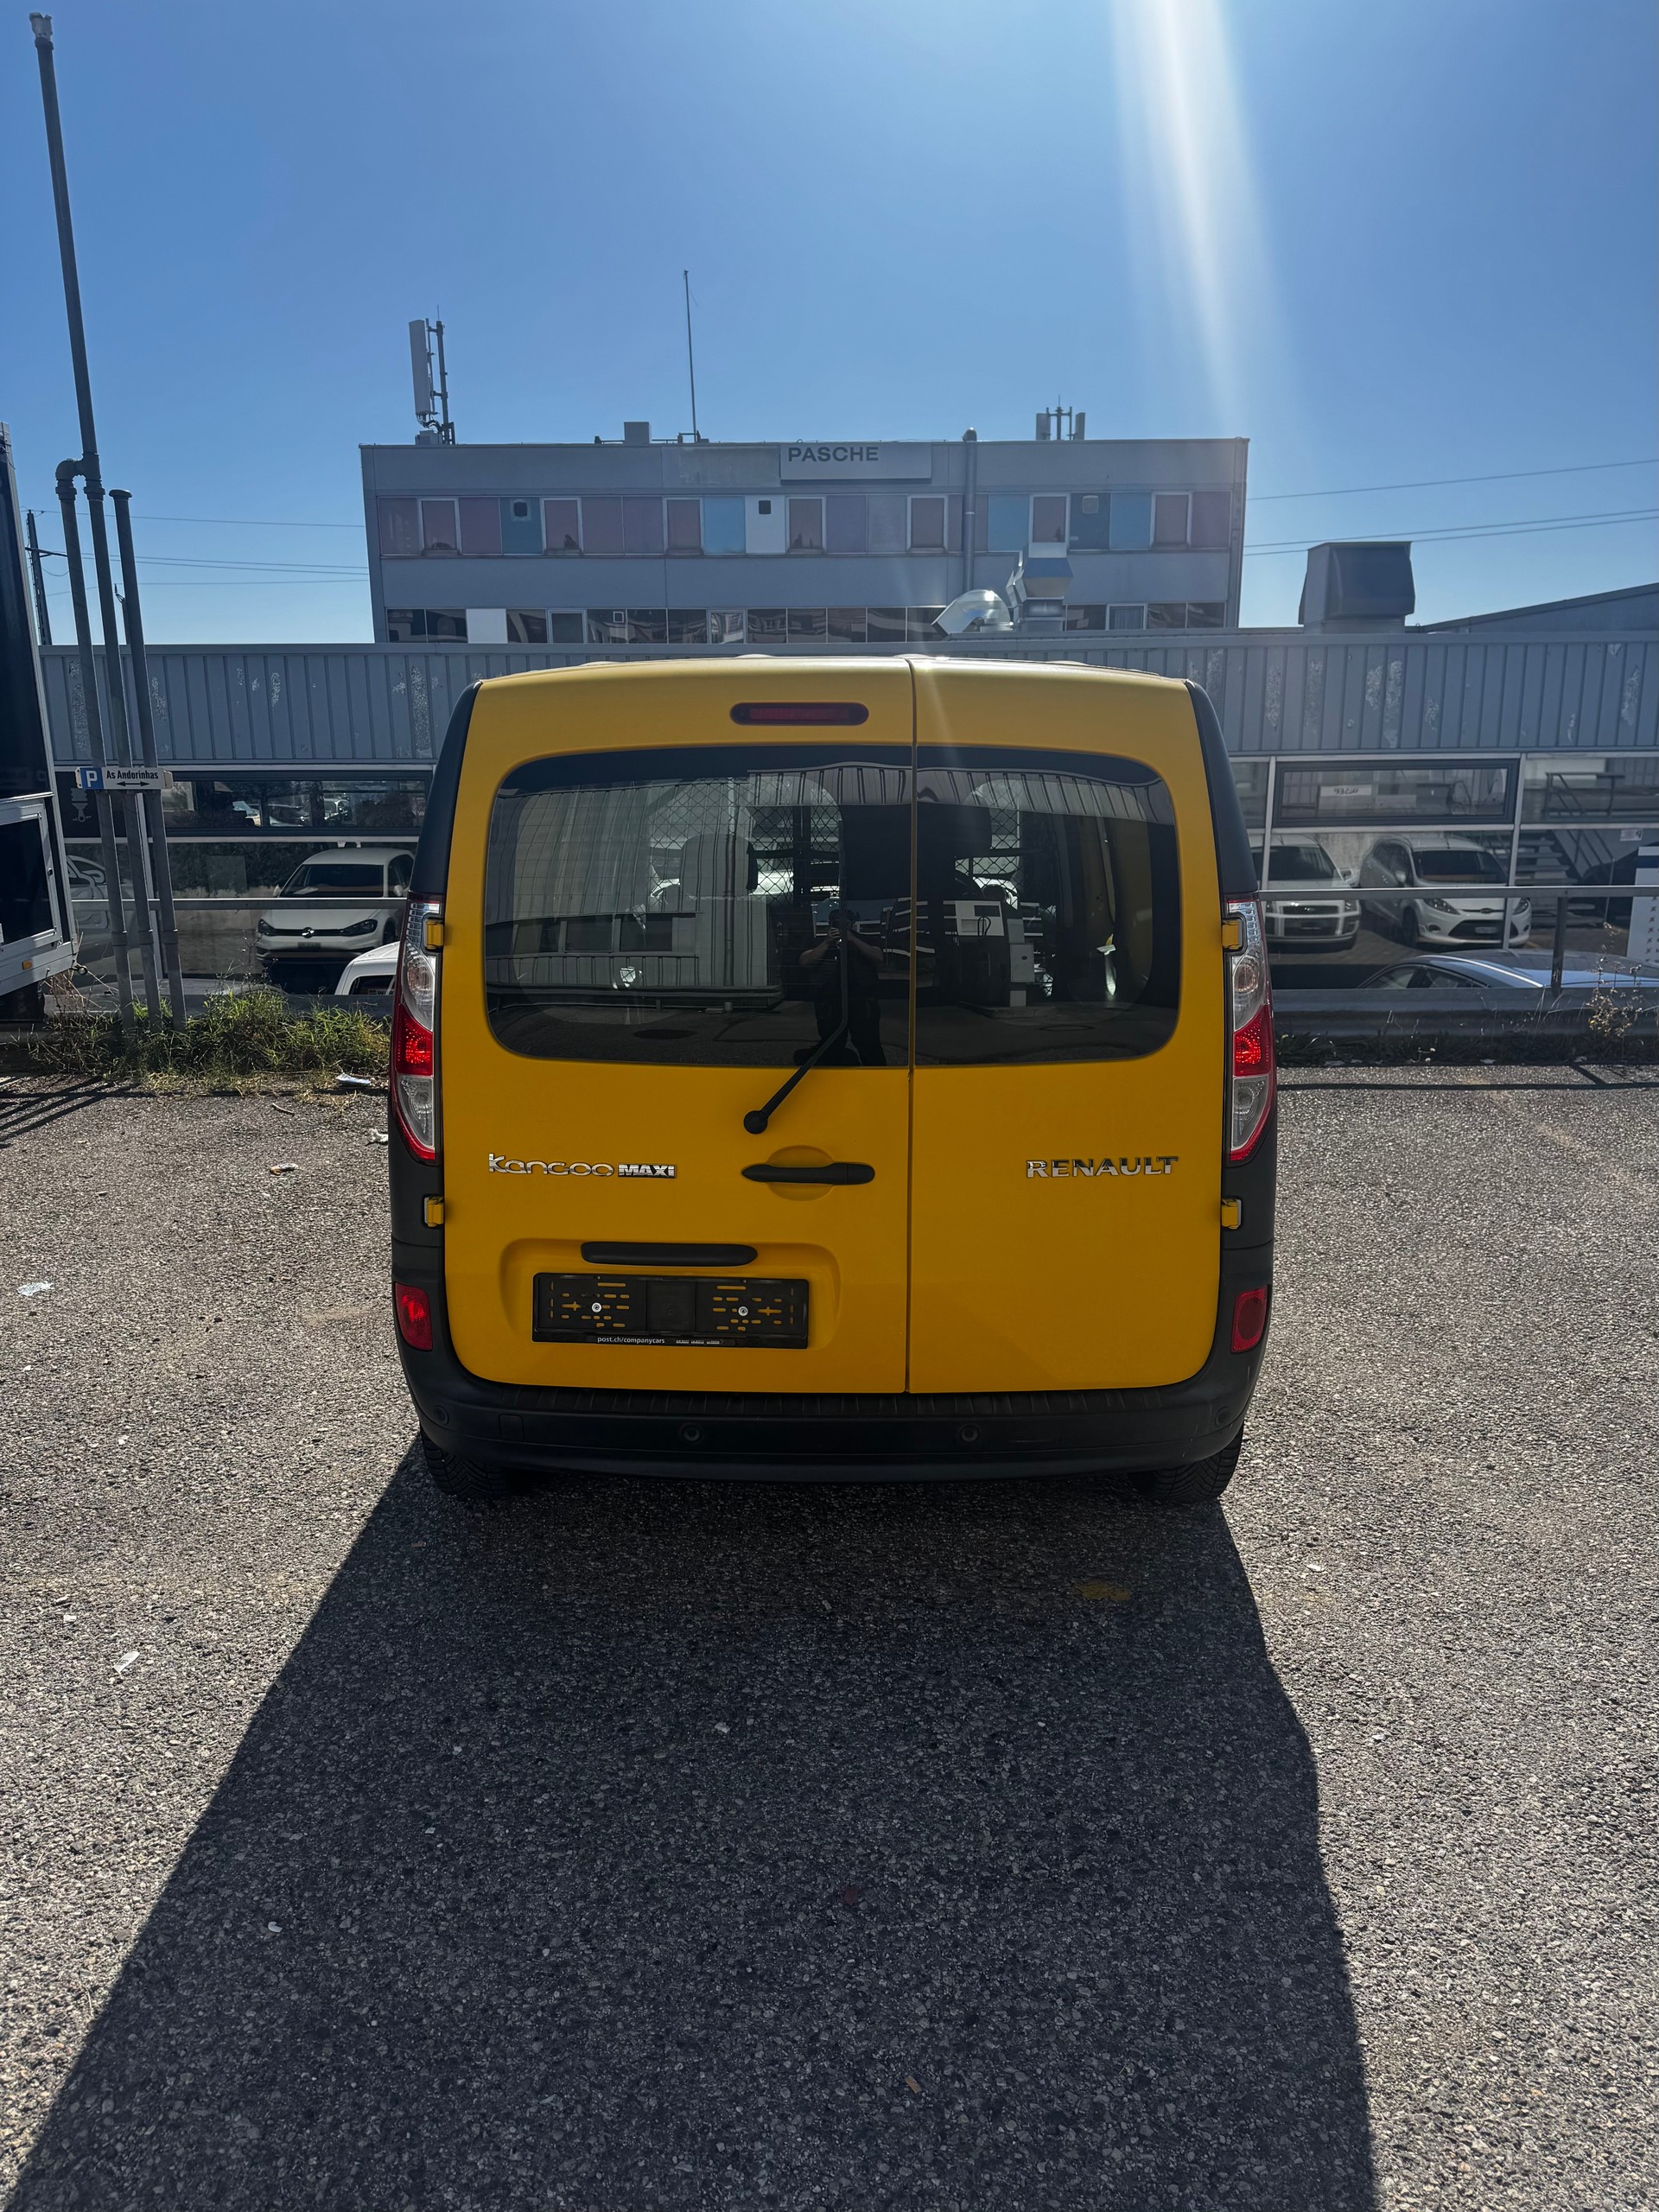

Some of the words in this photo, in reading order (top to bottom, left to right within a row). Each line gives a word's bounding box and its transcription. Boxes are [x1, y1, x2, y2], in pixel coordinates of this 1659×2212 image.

[788, 446, 879, 462] PASCHE
[86, 770, 98, 788] P
[106, 770, 115, 779] As
[117, 770, 159, 779] Andorinhas
[618, 1163, 676, 1178] MAXI
[1026, 1155, 1179, 1179] RENAULT
